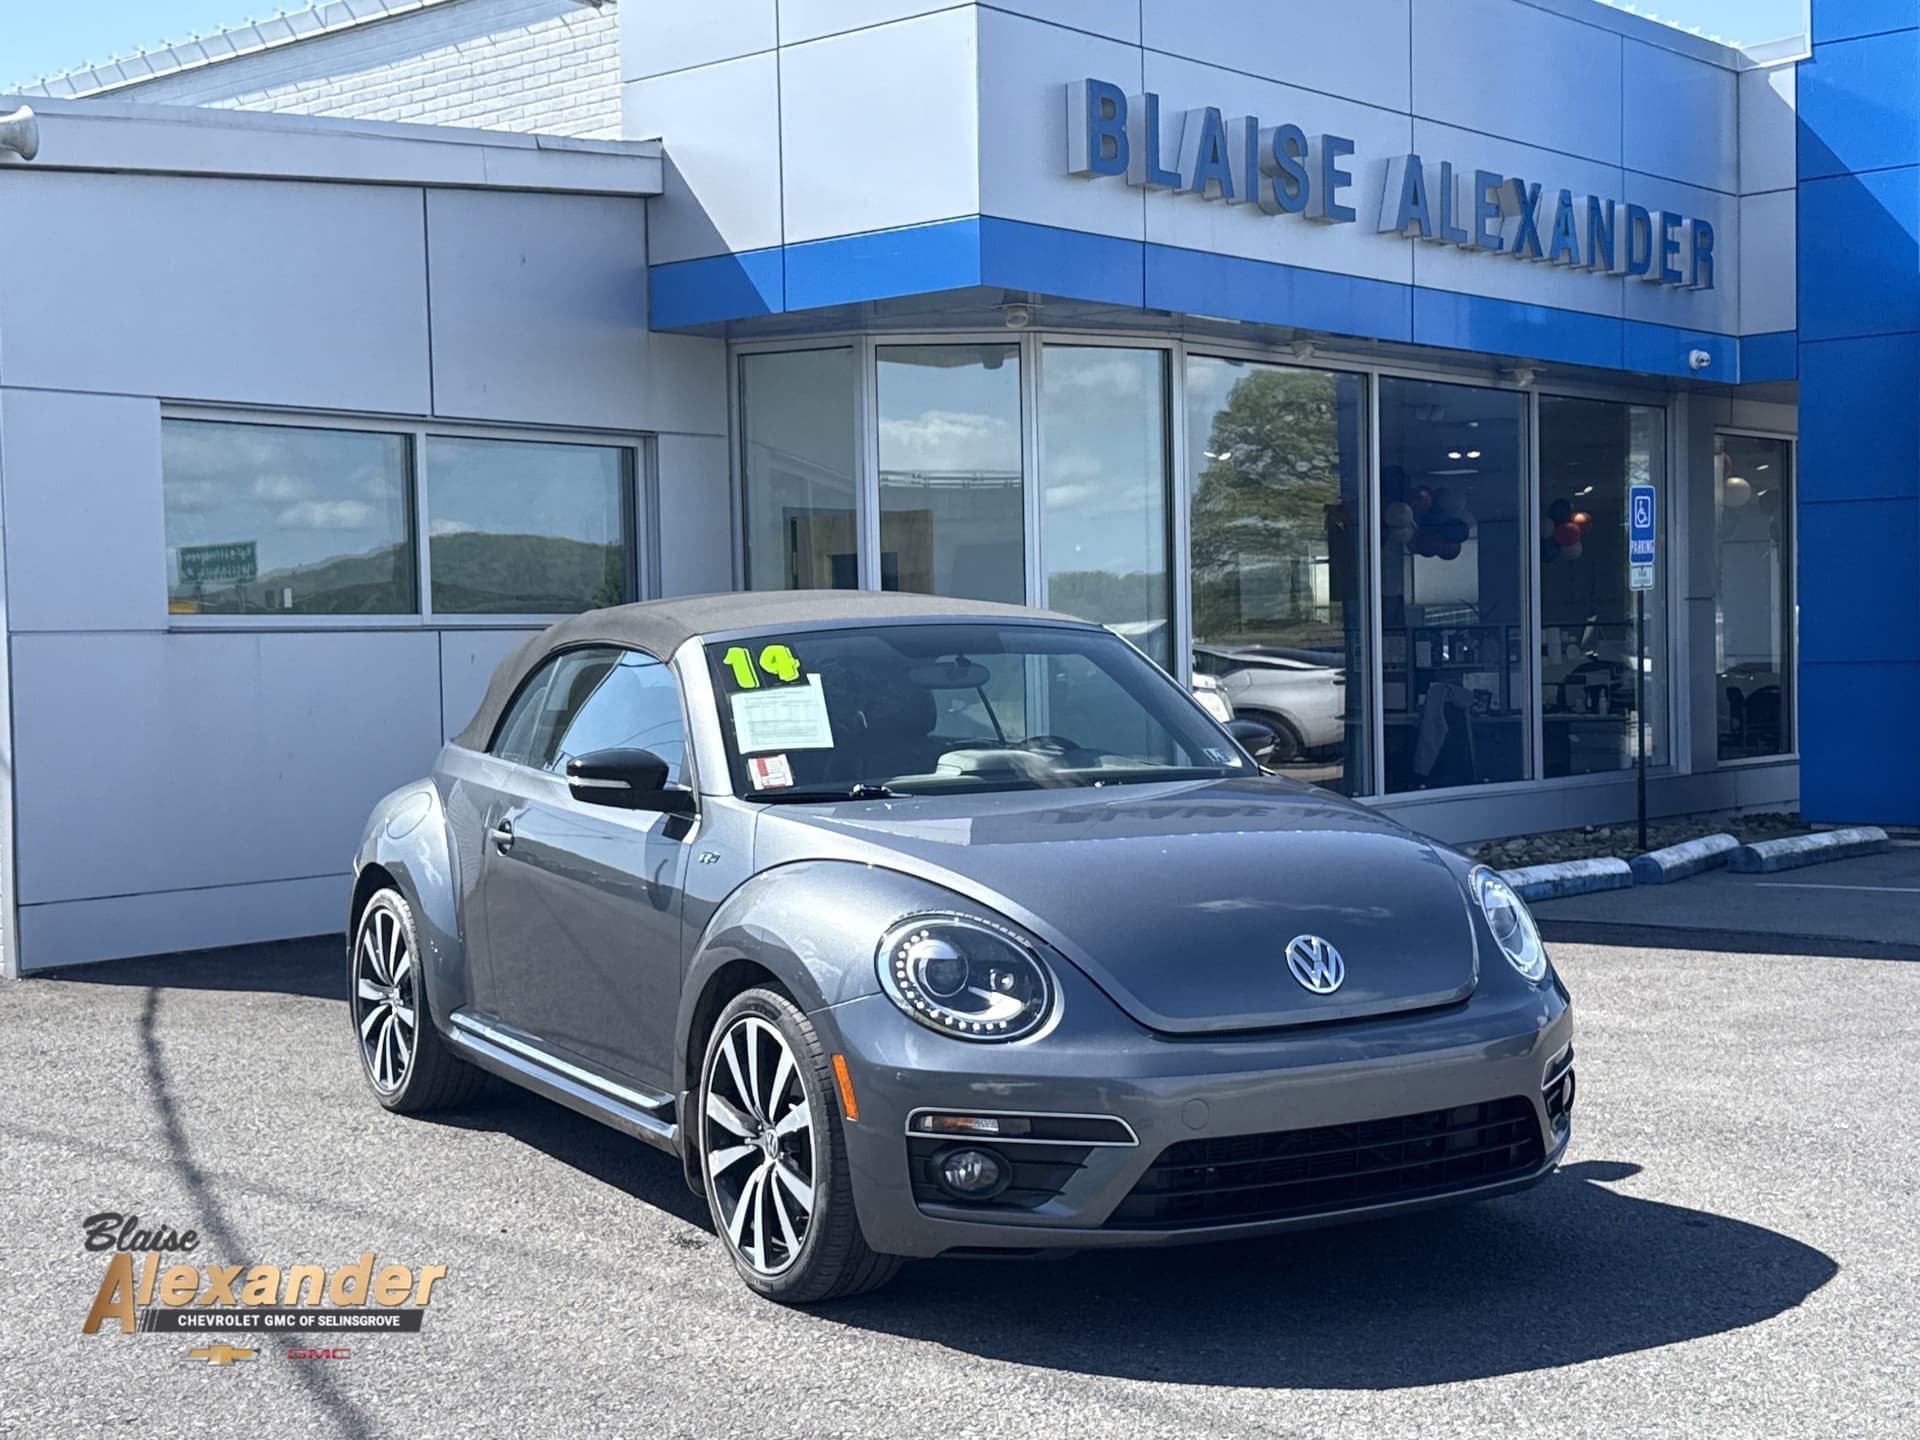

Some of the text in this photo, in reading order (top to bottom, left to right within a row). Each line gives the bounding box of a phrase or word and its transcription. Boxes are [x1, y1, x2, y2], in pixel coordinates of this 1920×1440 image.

[1069, 78, 1715, 290] BLAISE ALEXANDER
[723, 644, 800, 688] 14
